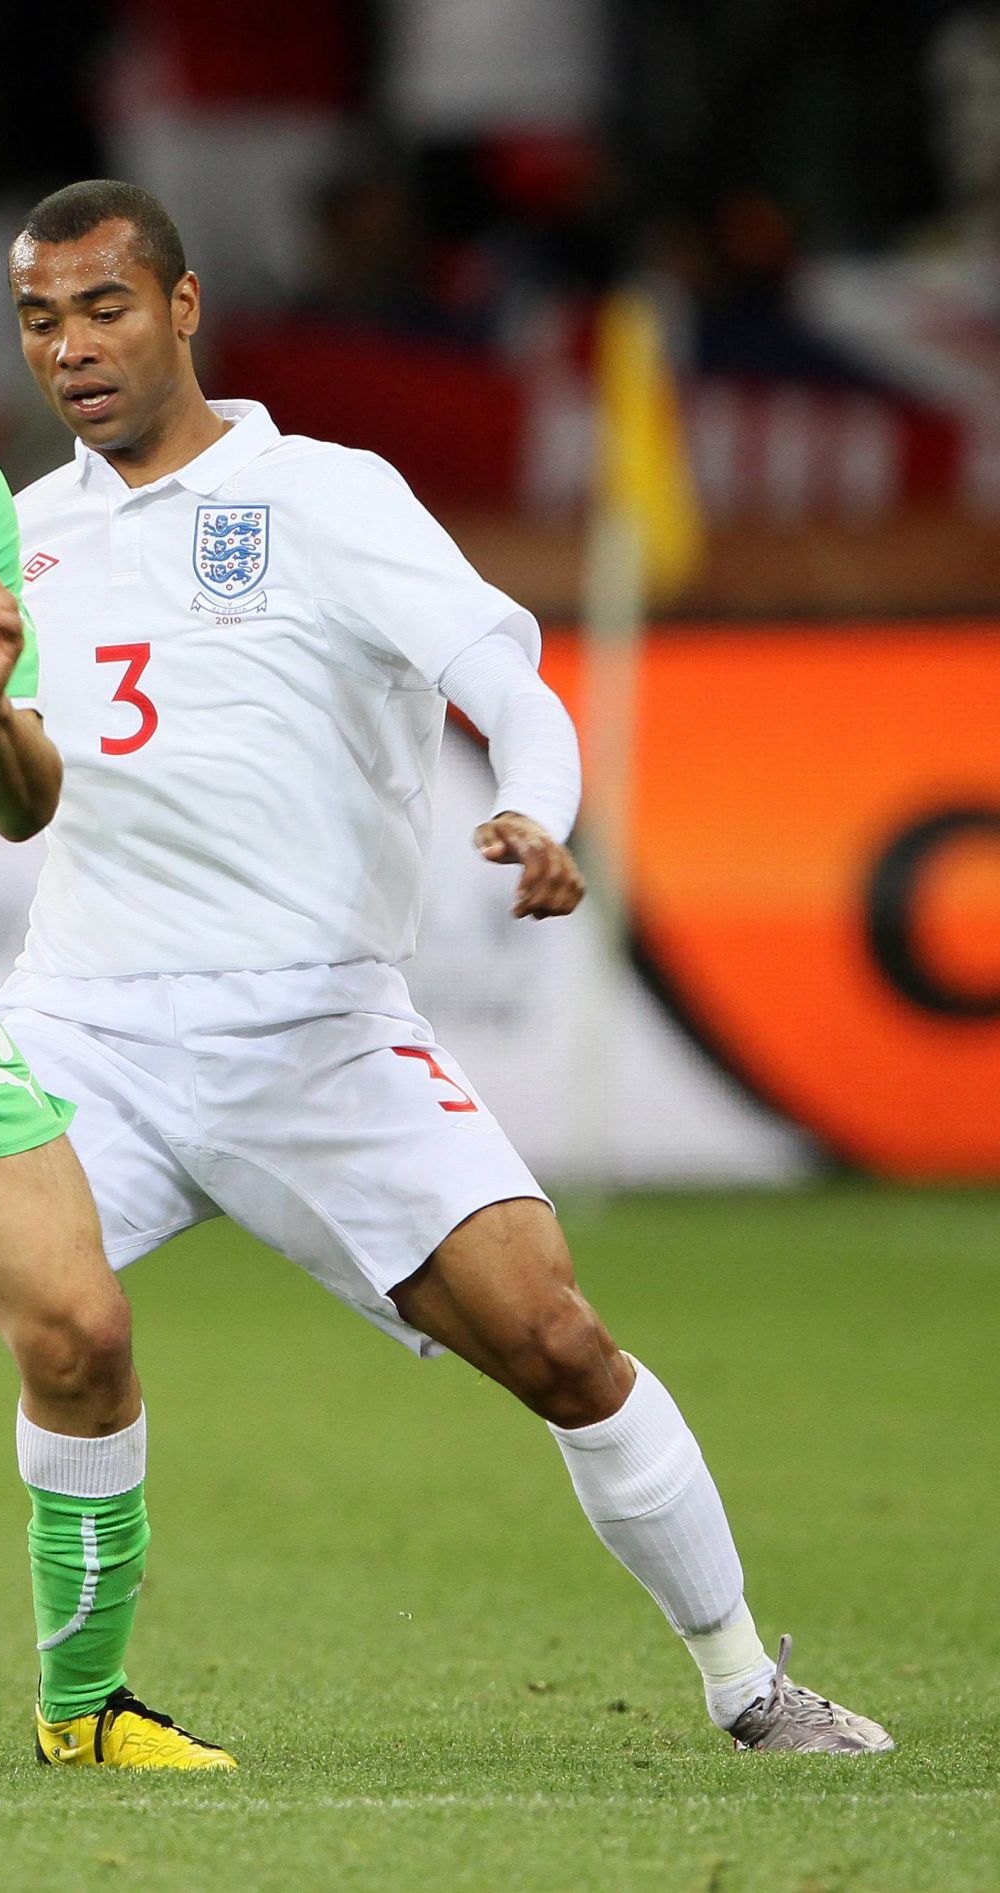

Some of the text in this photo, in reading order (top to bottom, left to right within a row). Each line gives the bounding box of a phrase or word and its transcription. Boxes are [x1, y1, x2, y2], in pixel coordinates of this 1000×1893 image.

[215, 616, 242, 625] 2010
[95, 642, 158, 756] 3
[391, 1046, 479, 1112] 3
